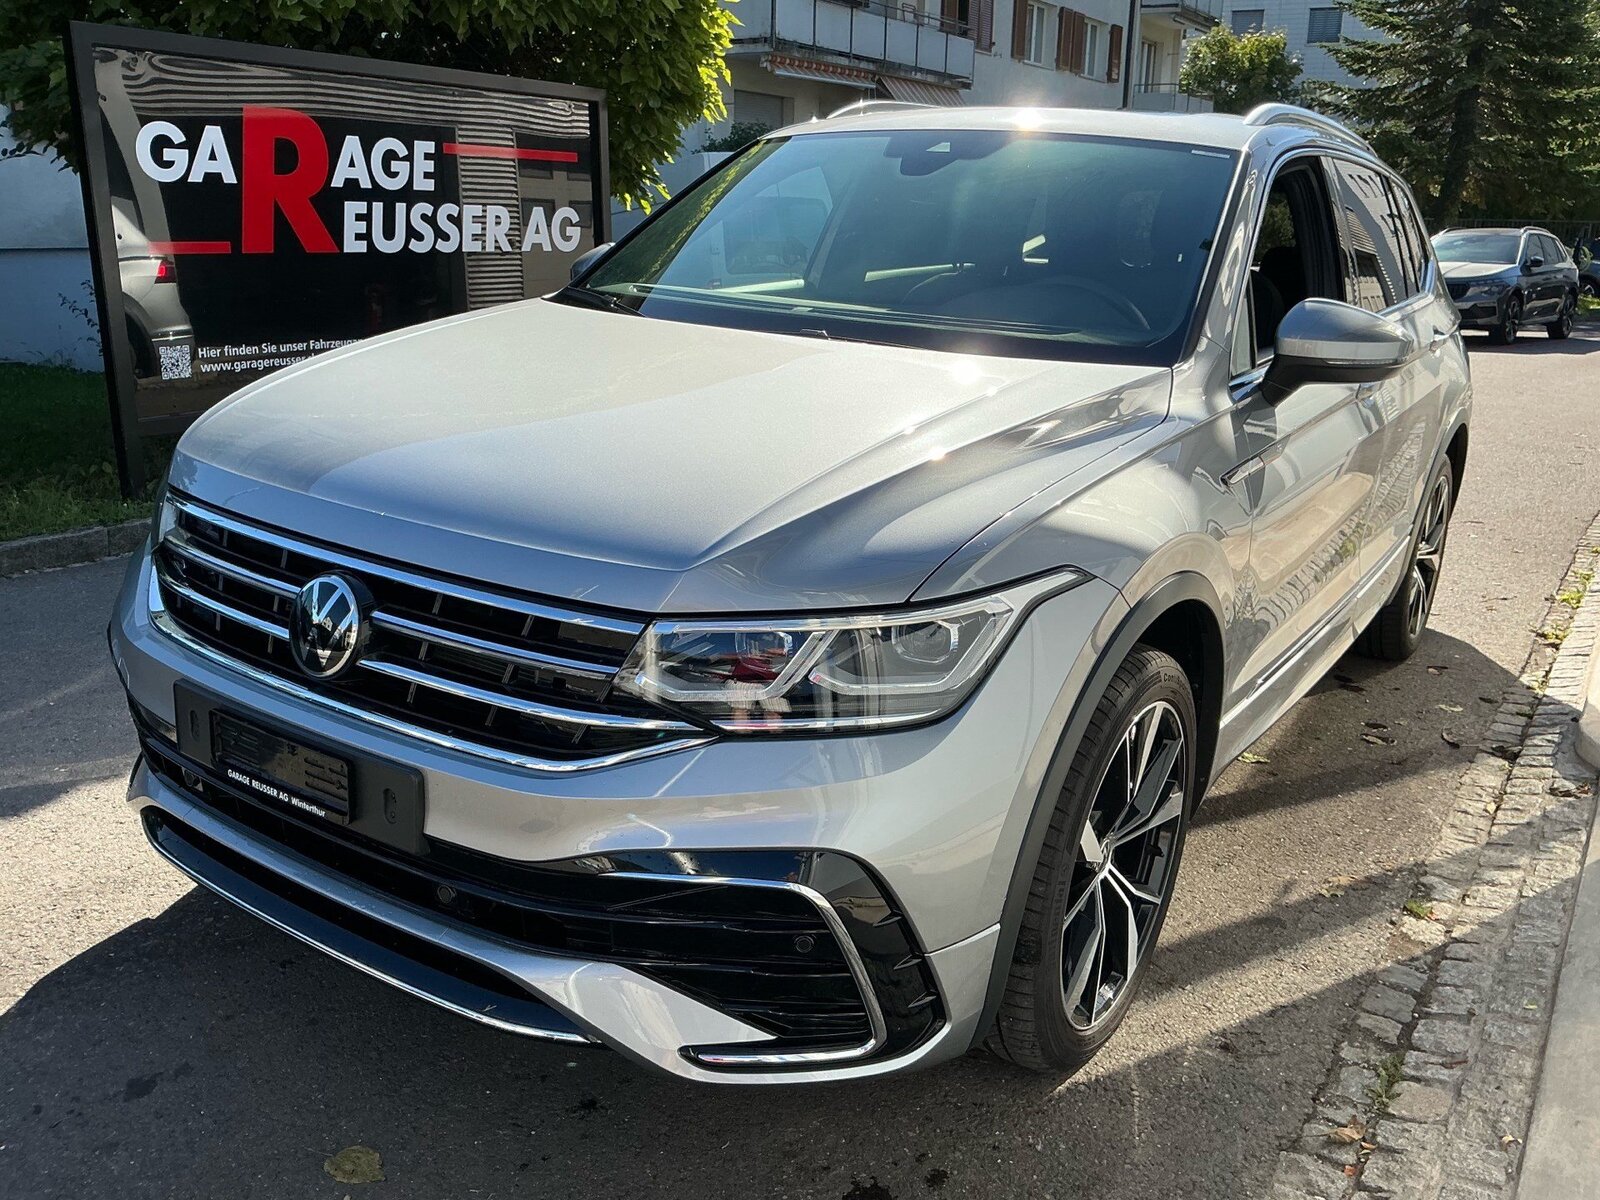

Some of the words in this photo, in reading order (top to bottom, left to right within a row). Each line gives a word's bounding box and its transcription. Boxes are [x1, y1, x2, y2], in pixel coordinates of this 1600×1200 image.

[135, 105, 436, 254] GARAGE
[521, 206, 582, 253] AG
[198, 346, 222, 359] Hier
[223, 343, 260, 357] finden
[261, 341, 278, 354] Sie
[279, 342, 308, 353] unser
[200, 352, 315, 373] www.garagereusser
[227, 768, 250, 786] GARAGE
[251, 779, 278, 798] REUSSER
[279, 791, 289, 802] AG
[291, 796, 326, 818] Winterthur
